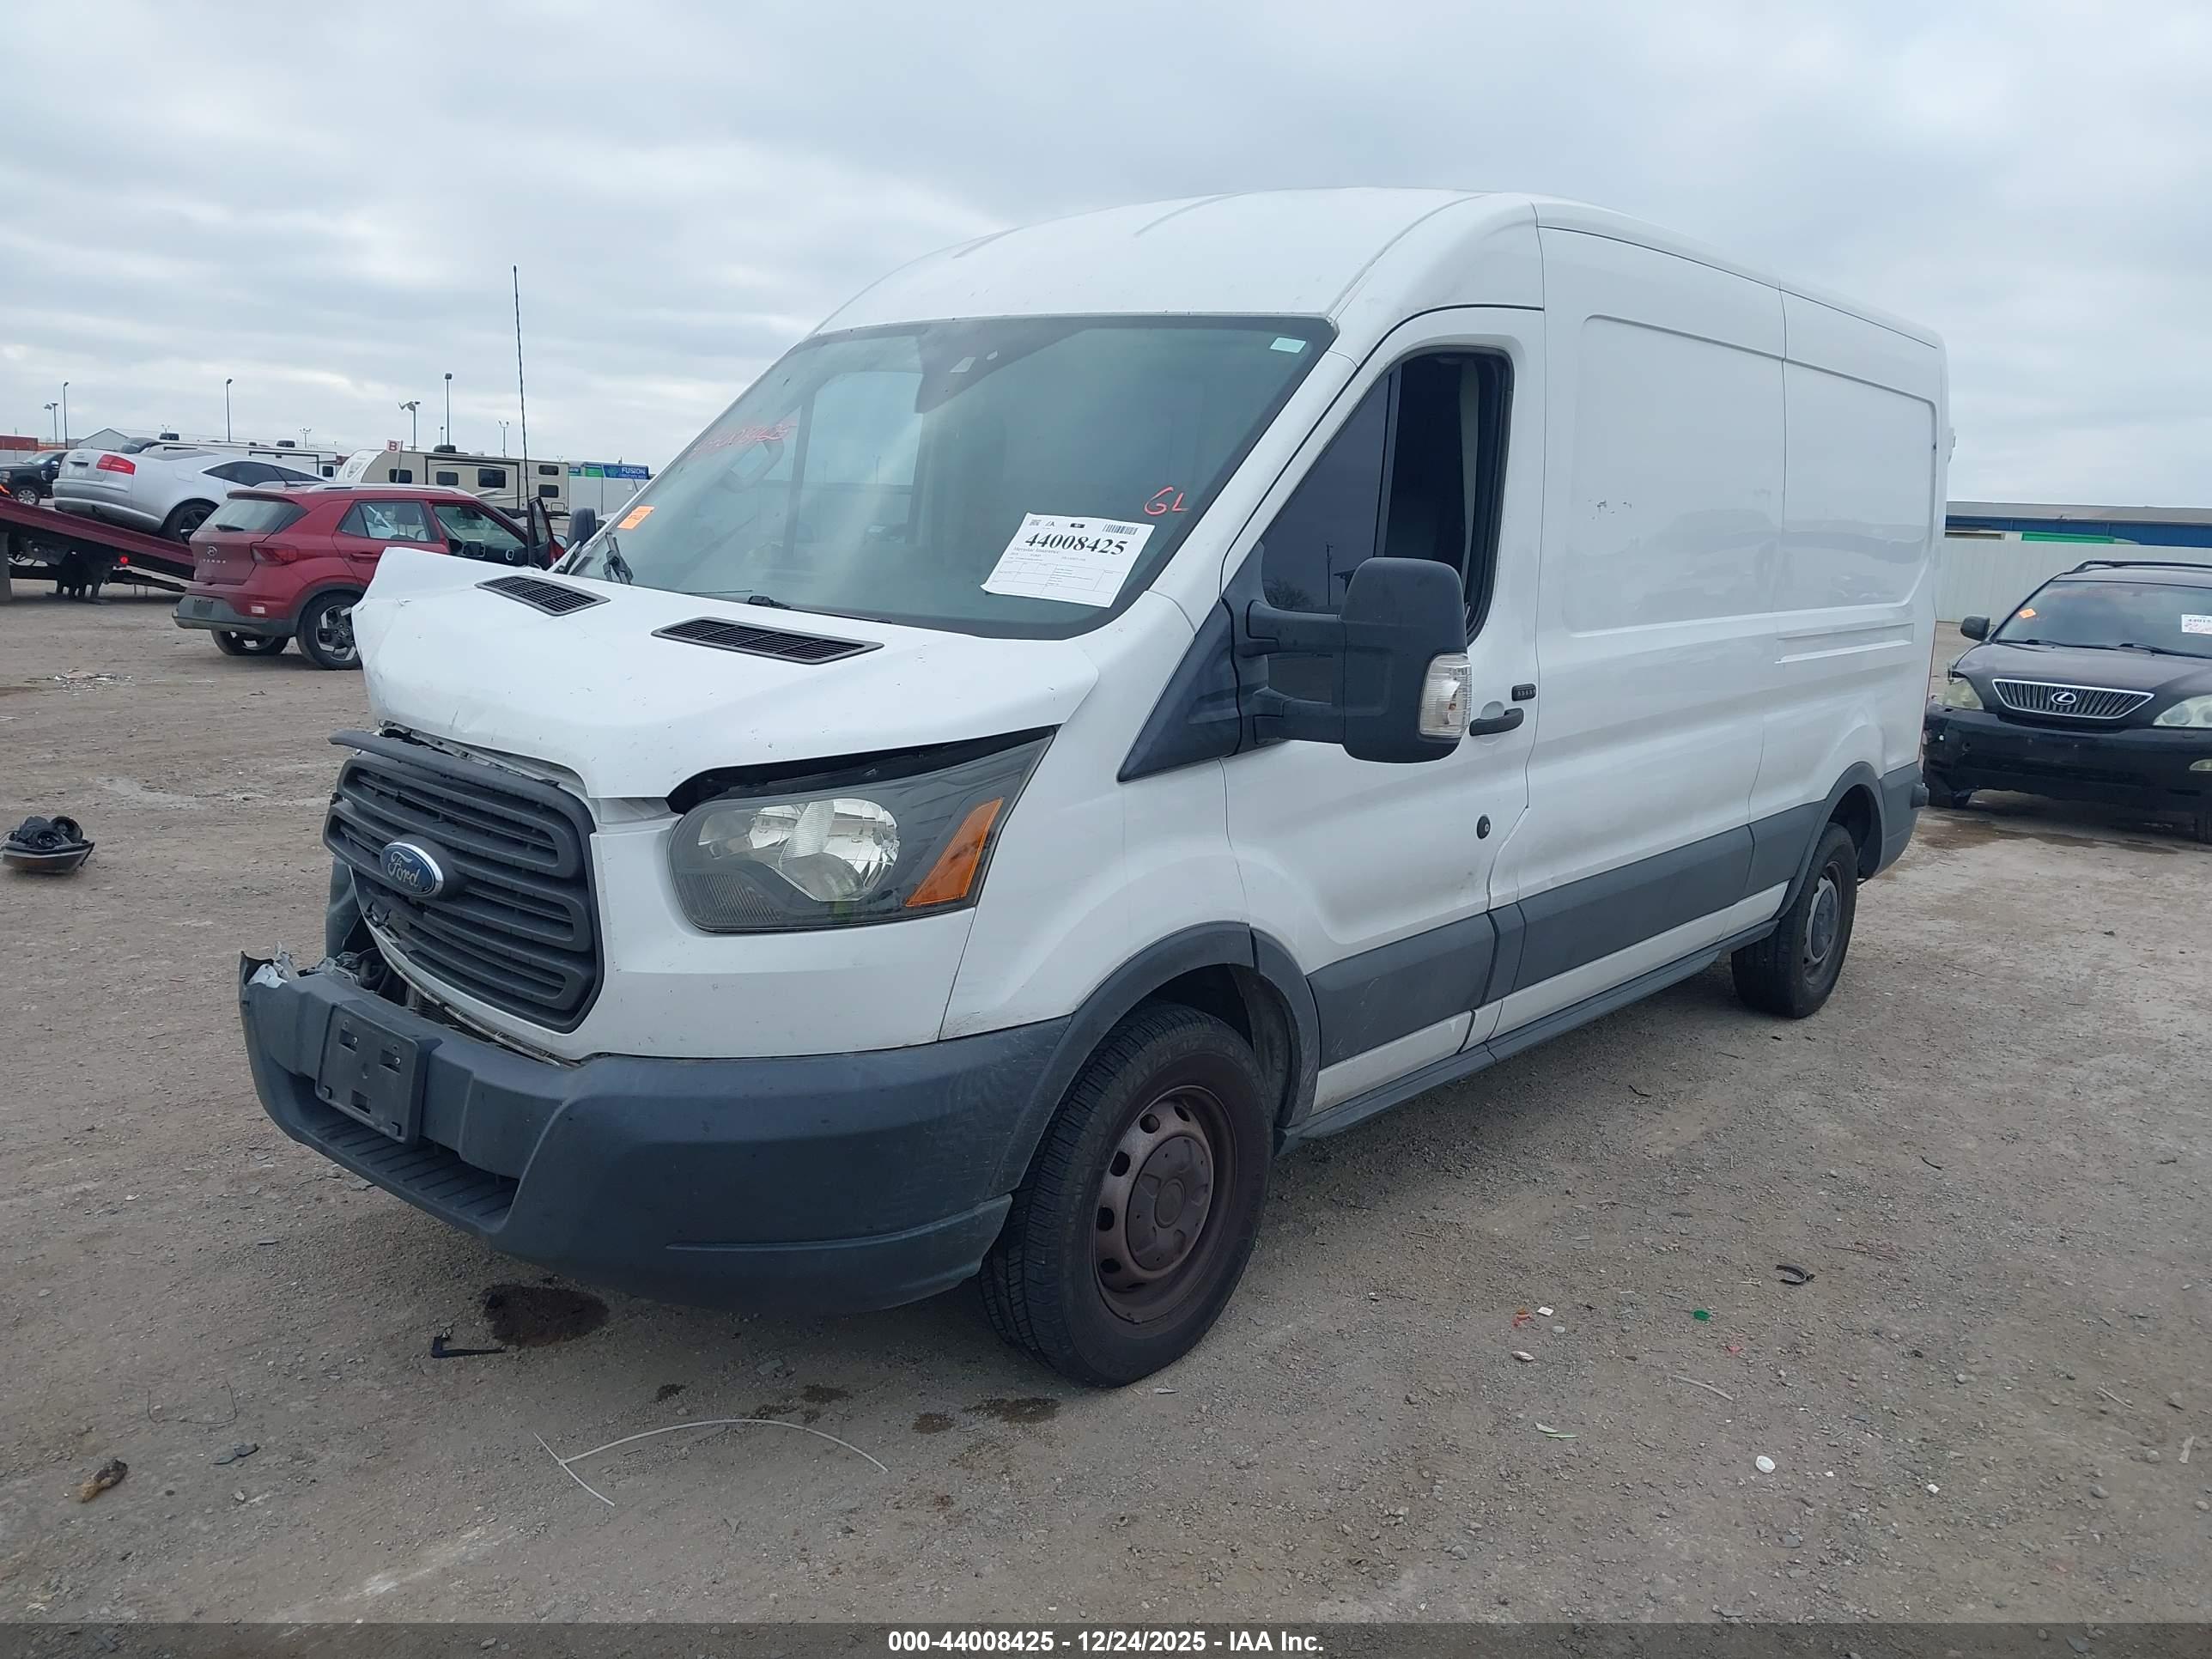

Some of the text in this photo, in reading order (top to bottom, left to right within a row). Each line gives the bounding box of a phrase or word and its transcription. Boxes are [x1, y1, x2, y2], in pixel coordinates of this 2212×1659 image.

[389, 441, 398, 451] B
[621, 466, 646, 475] FUSION
[1024, 532, 1128, 555] 44008425
[387, 851, 420, 887] Ford
